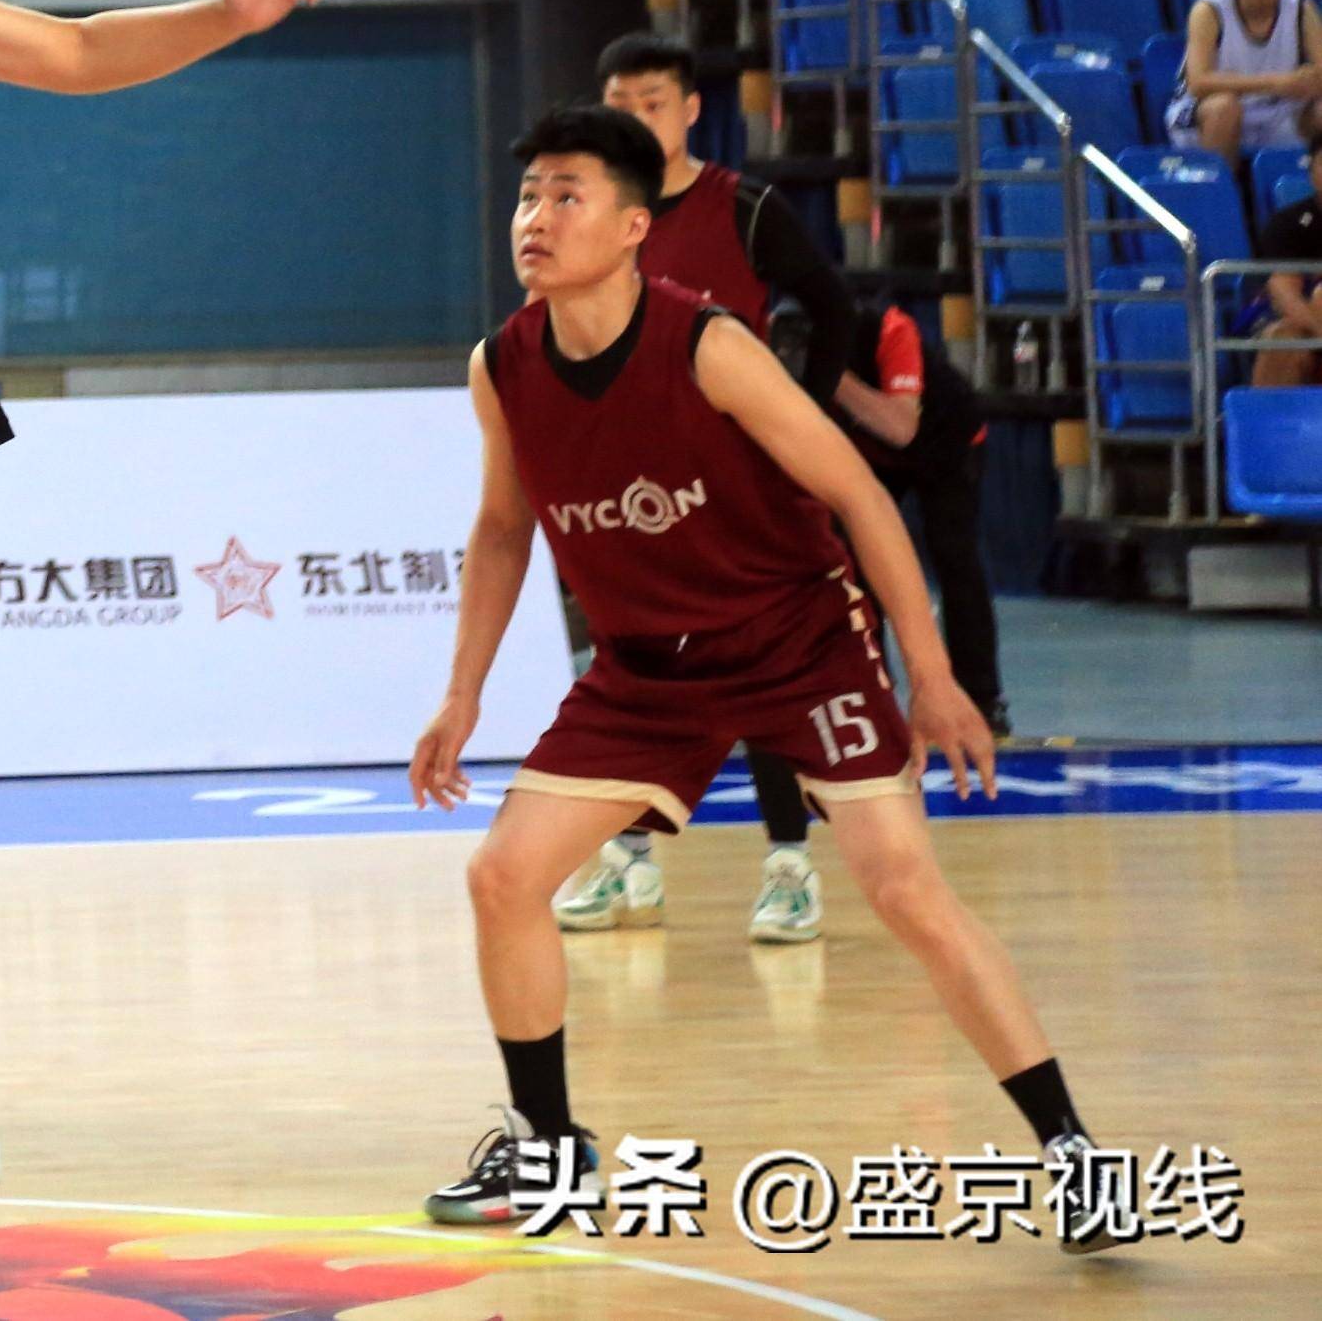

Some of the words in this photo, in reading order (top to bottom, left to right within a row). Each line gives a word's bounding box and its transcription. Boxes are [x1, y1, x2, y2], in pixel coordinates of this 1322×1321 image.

[547, 475, 707, 536] VYCON
[97, 604, 183, 628] GROUP
[808, 692, 880, 769] 15
